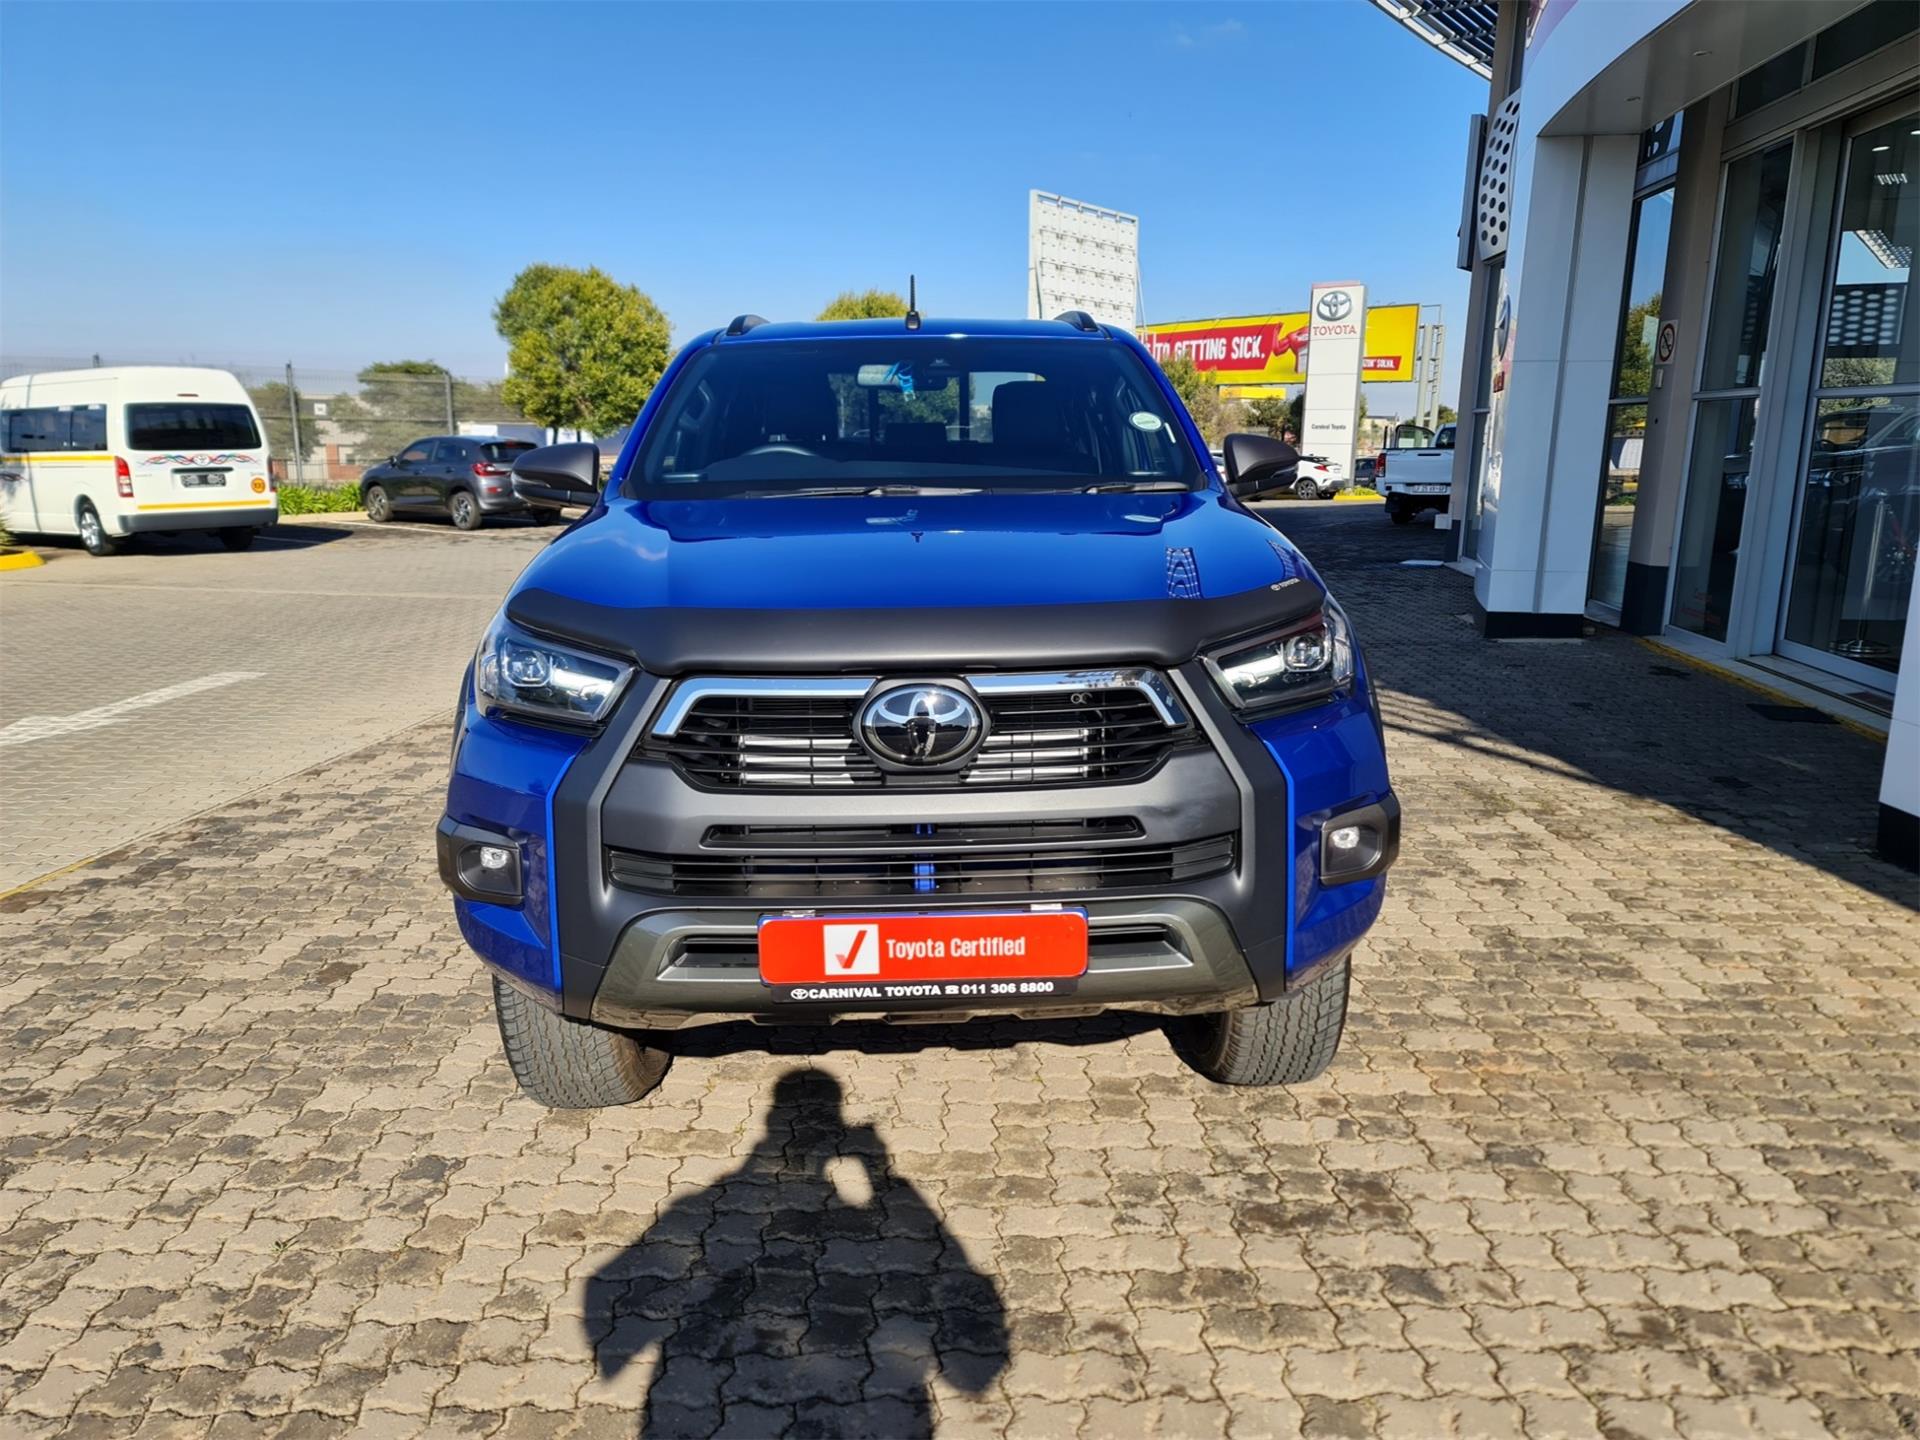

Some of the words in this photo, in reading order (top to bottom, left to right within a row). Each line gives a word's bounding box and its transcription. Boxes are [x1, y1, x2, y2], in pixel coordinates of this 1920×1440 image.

[1312, 325, 1357, 336] TOYOTA
[1231, 335, 1265, 359] SICK.
[886, 937, 944, 960] Toyota
[950, 935, 1026, 958] Certified
[808, 986, 882, 999] CARNIVAL
[885, 984, 941, 997] TOYOTA
[961, 983, 986, 995] 011
[990, 982, 1016, 994] 306
[1020, 981, 1054, 993] 8800
